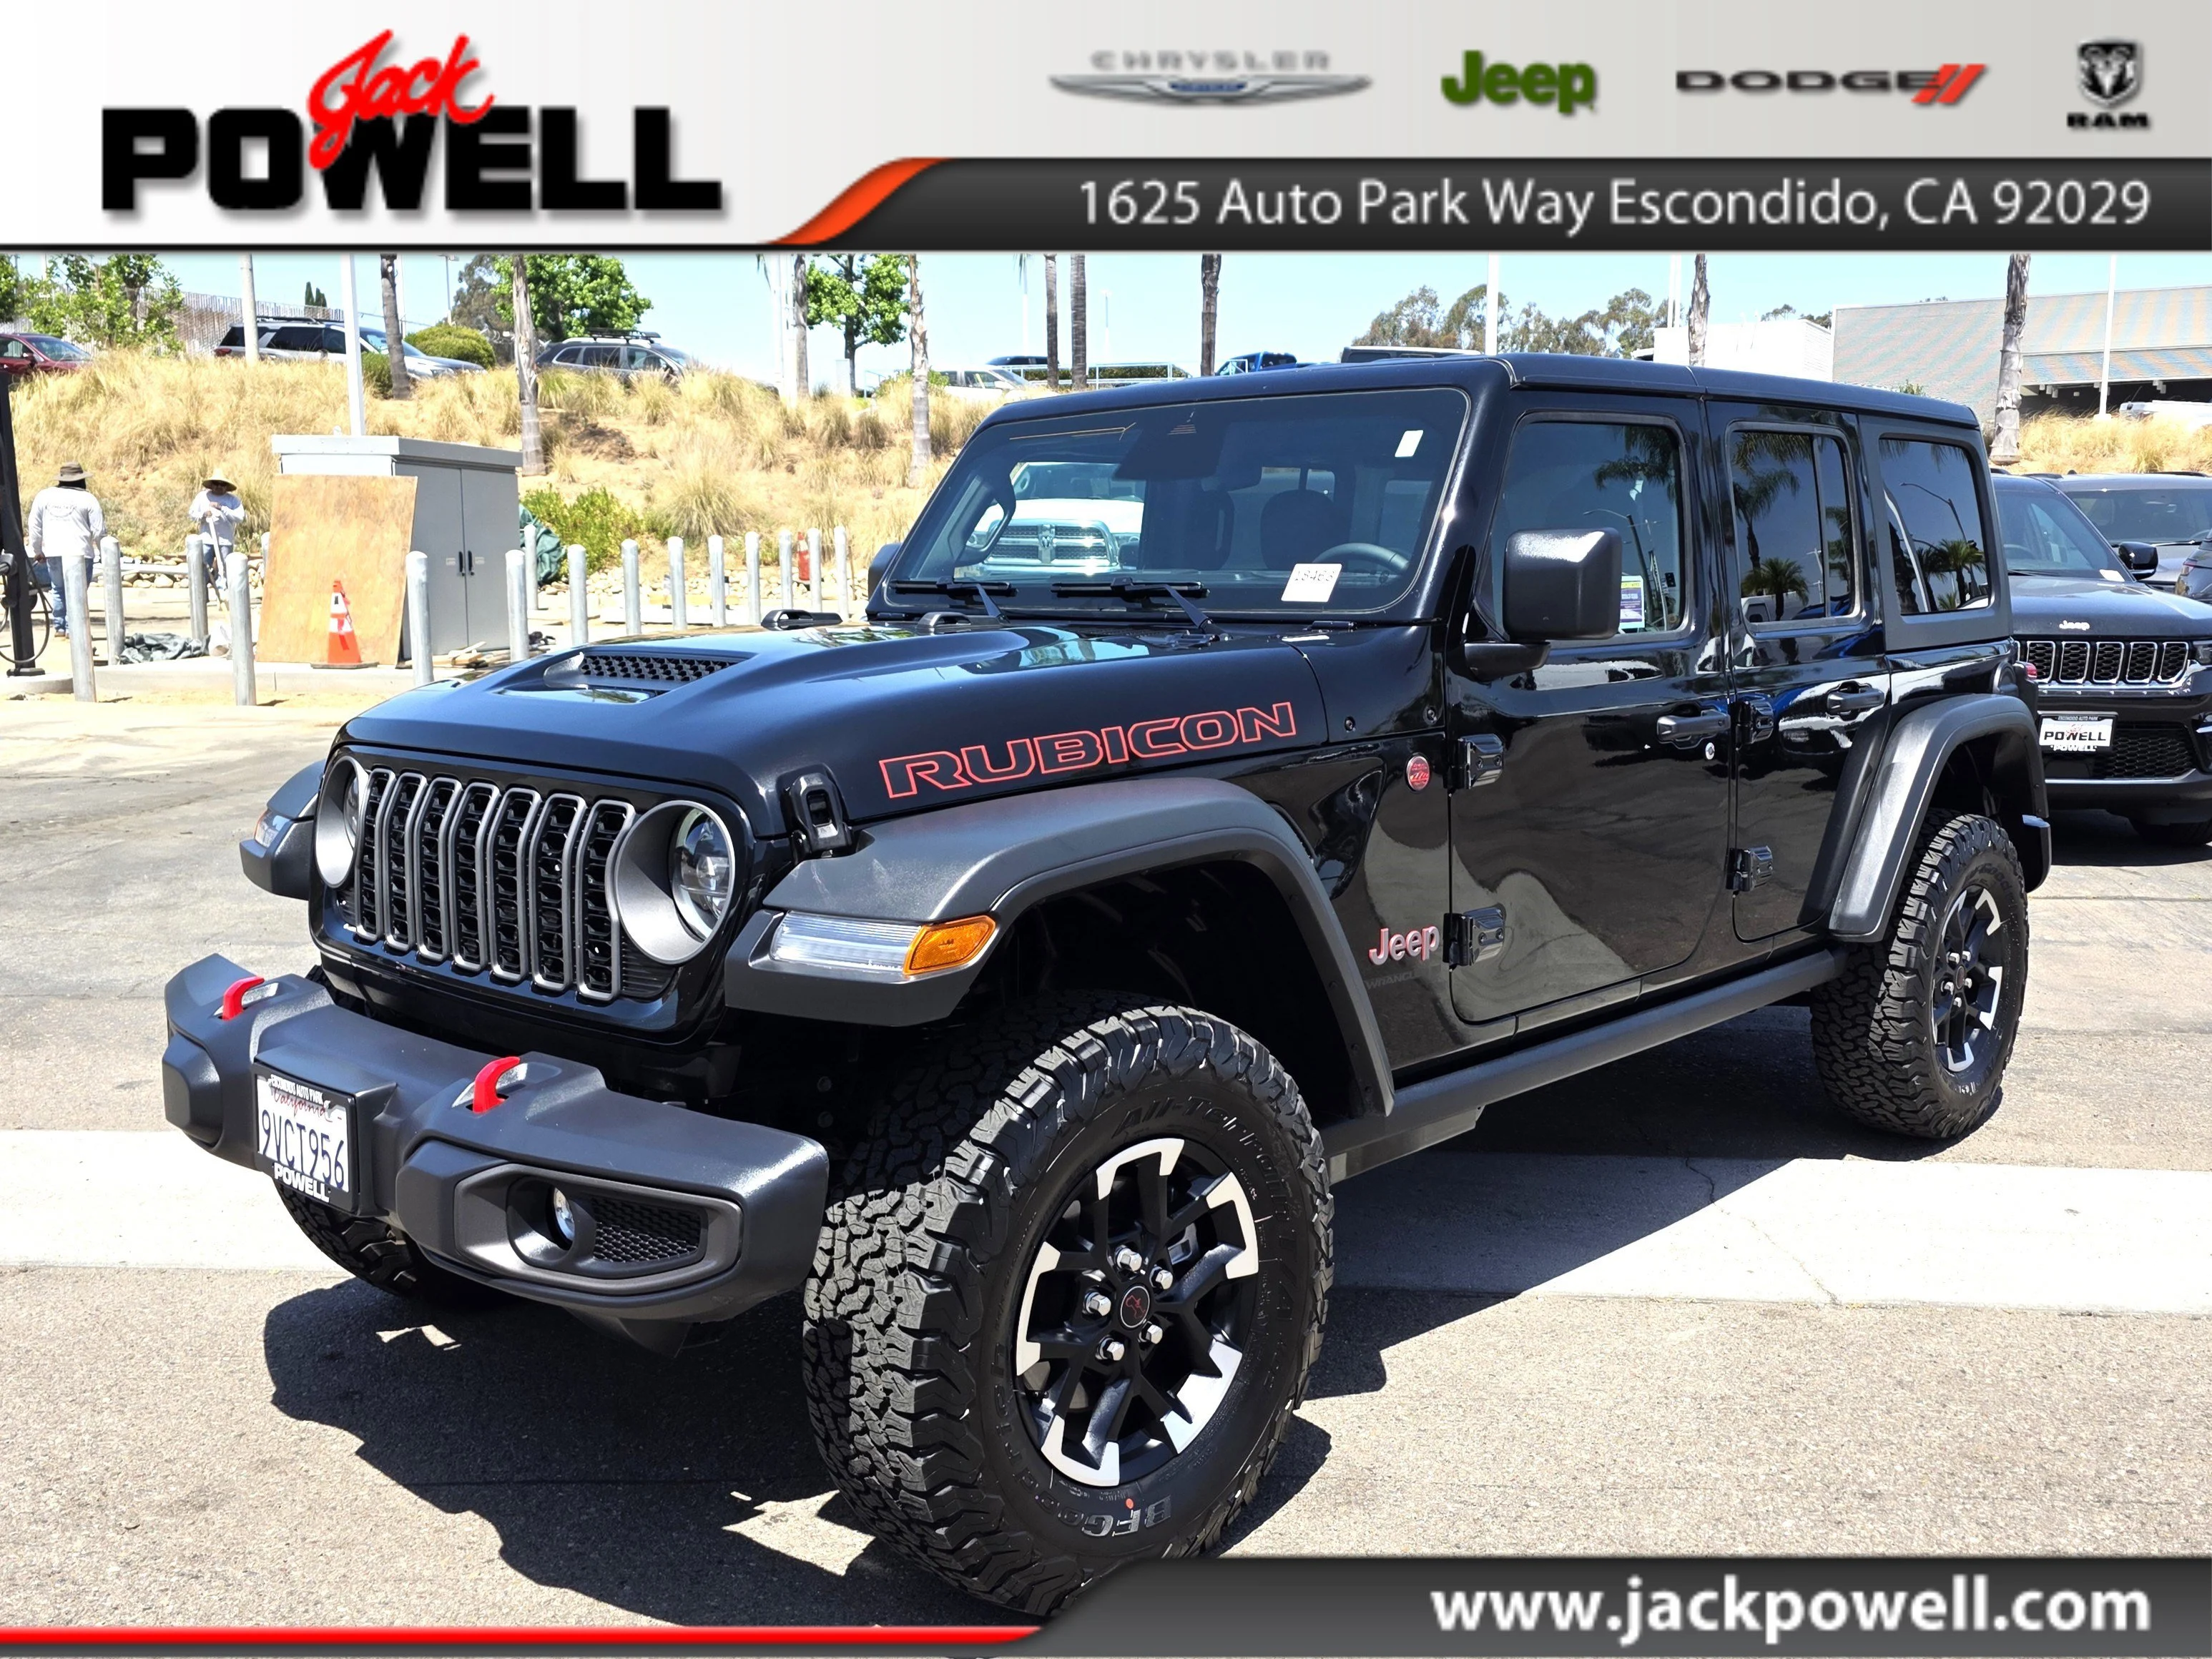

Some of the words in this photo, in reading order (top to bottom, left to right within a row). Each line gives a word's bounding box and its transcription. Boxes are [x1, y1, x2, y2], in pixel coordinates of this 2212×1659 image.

[879, 701, 1297, 799] RUBICON
[2044, 732, 2106, 741] POWELL
[1369, 926, 1440, 965] Jeep
[262, 1109, 345, 1189] 9VCT956
[274, 1162, 330, 1203] POWELL
